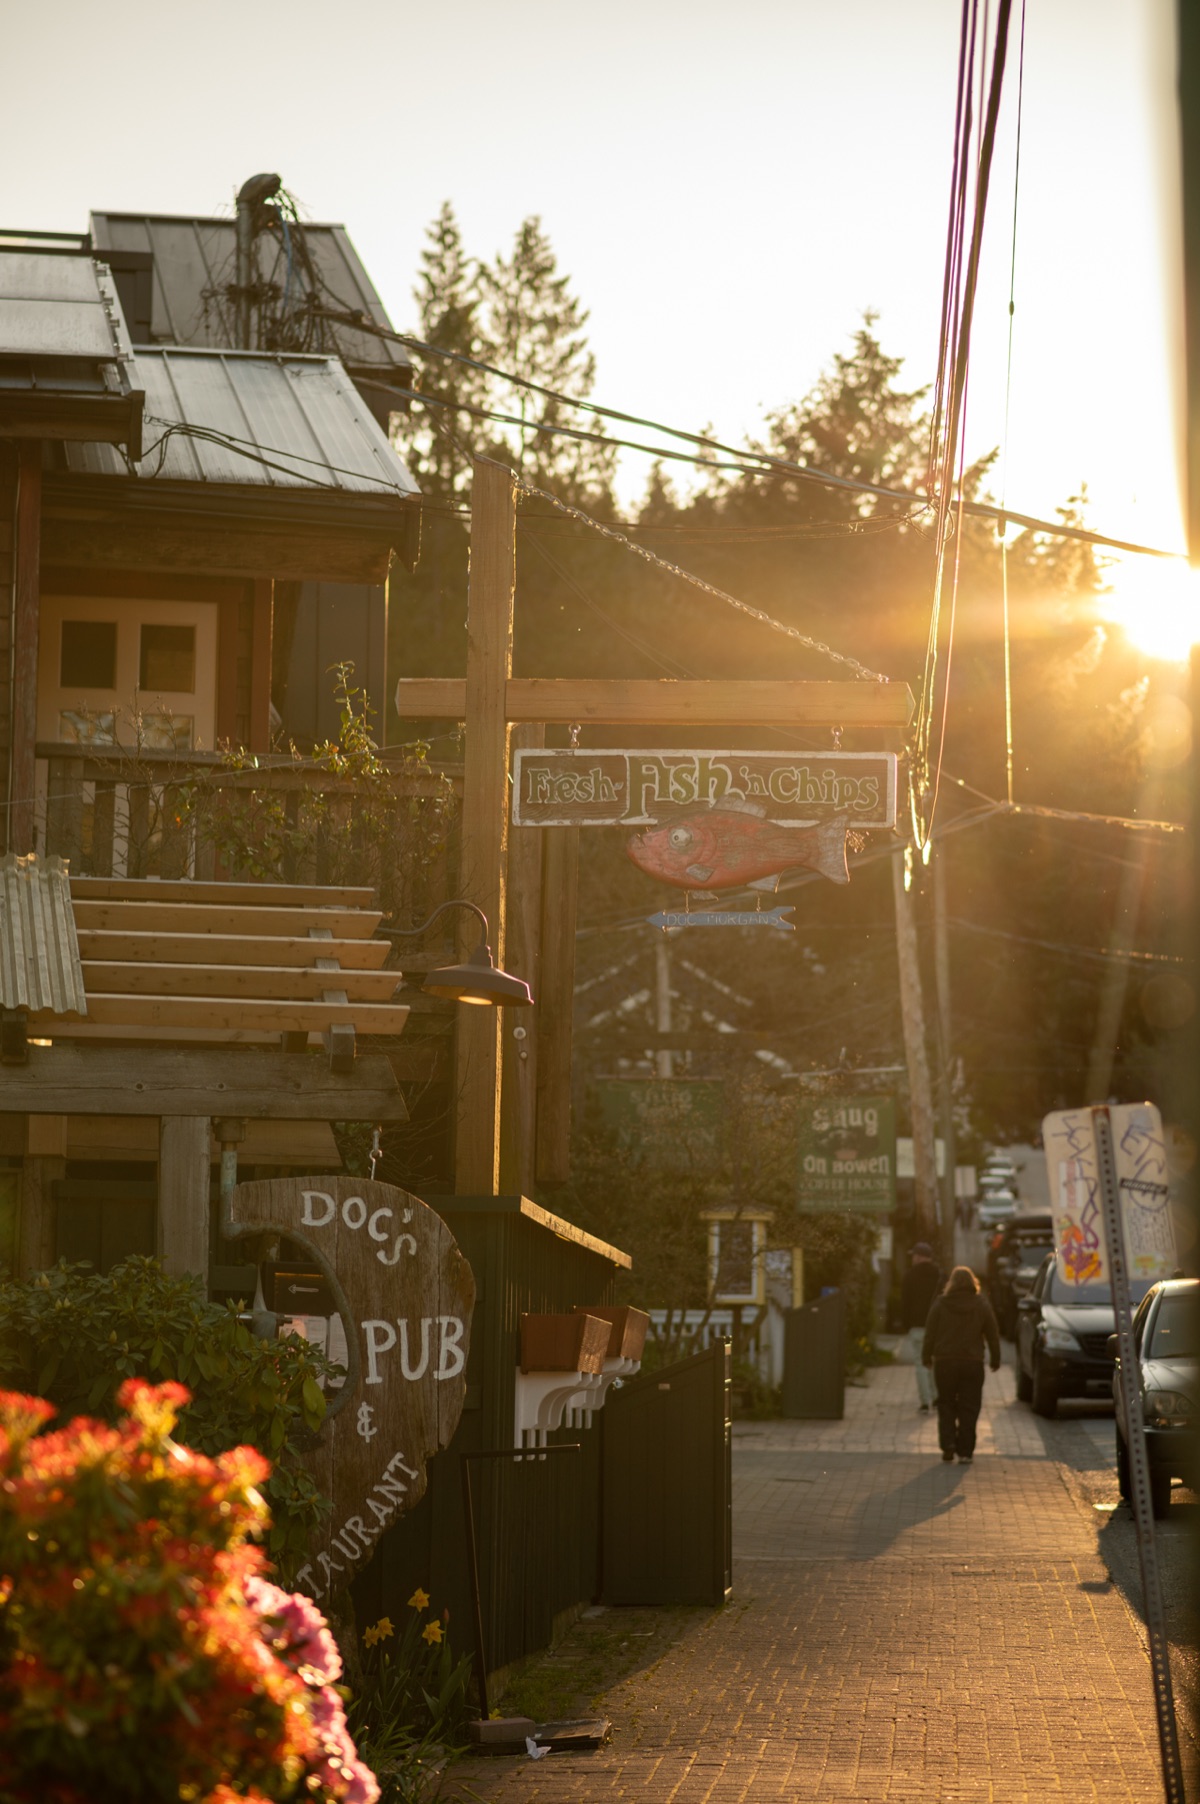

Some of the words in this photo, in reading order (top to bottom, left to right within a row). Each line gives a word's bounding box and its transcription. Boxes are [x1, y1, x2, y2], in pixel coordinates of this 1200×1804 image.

[527, 767, 619, 803] Fresh
[619, 755, 746, 820] Fish
[768, 766, 879, 811] Chips
[667, 913, 697, 926] DOC
[706, 912, 779, 926] MORGANS
[803, 1154, 828, 1175] On
[300, 1190, 417, 1266] DOC'S
[361, 1315, 465, 1384] PUB
[356, 1401, 378, 1443] &
[292, 1451, 419, 1599] TAURANT
